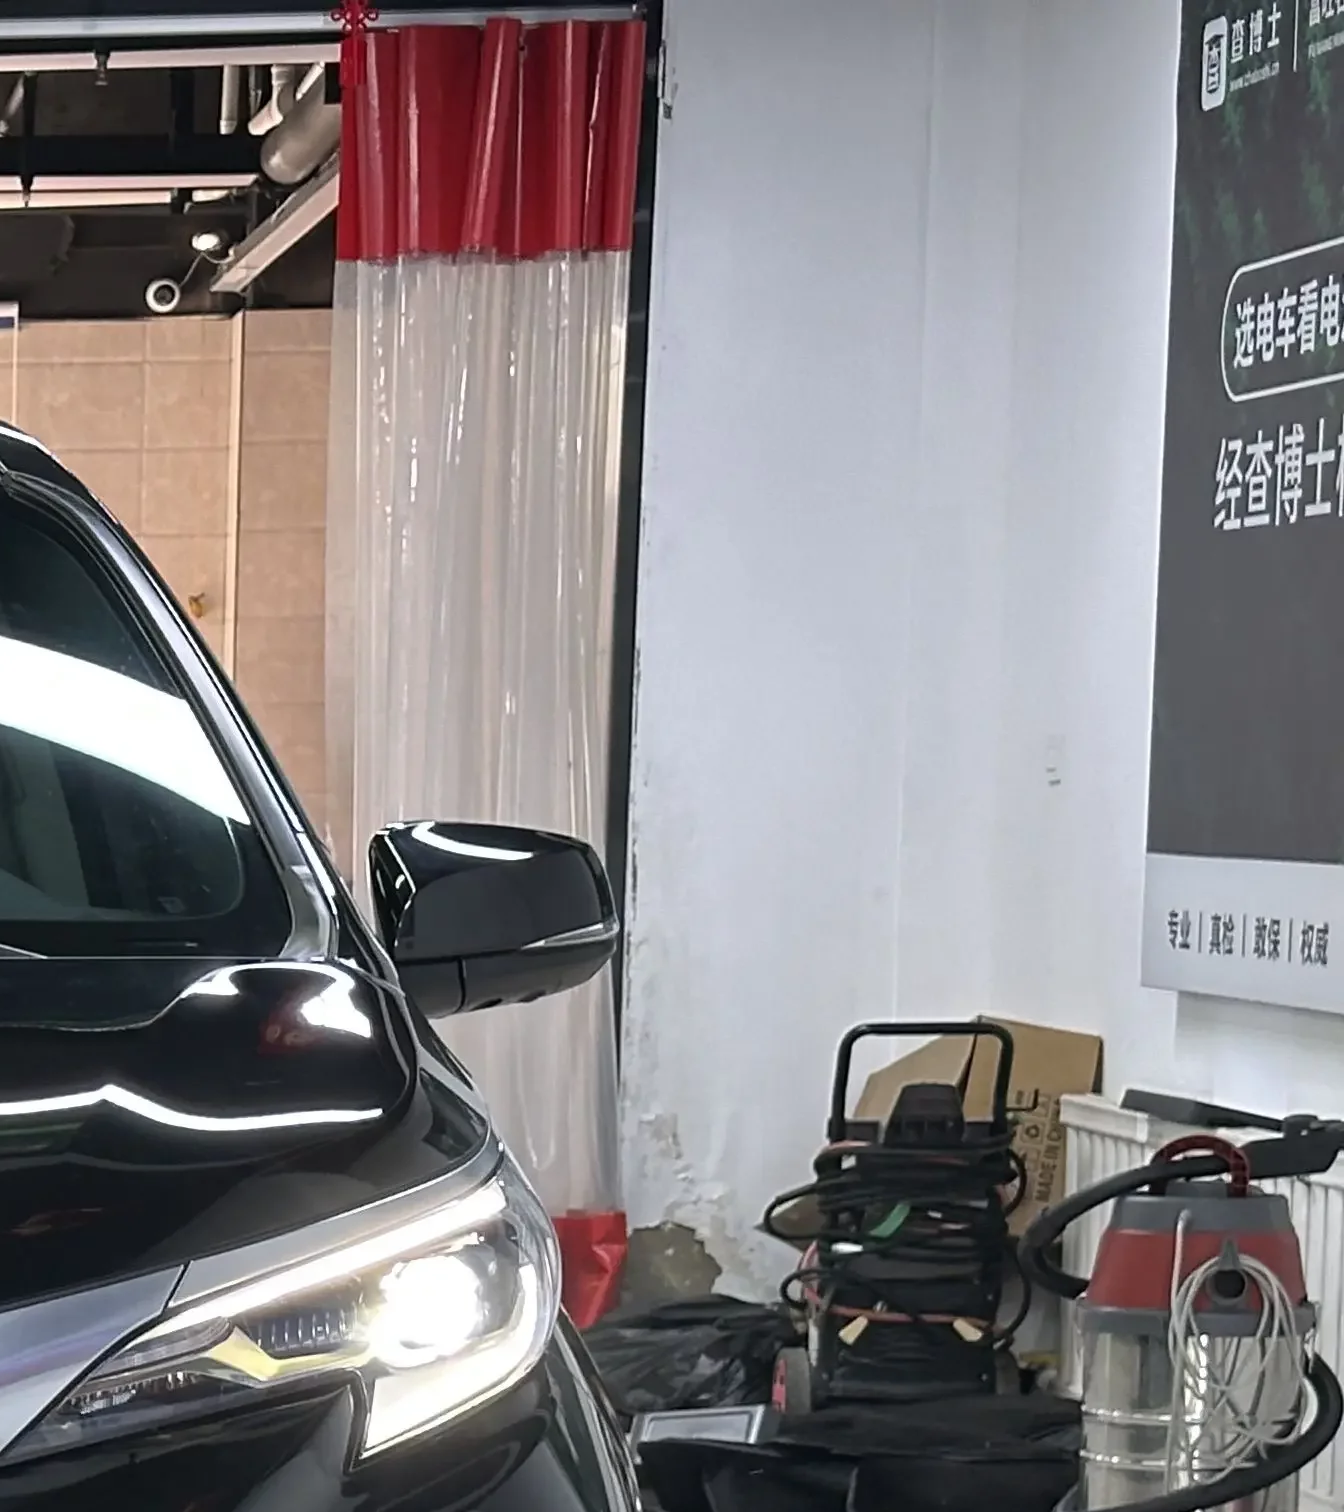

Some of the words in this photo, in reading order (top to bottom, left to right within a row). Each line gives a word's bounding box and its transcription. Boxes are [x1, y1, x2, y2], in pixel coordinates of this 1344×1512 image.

[1231, 2, 1282, 64] 查博士
[1234, 275, 1344, 369] 选电车看电
